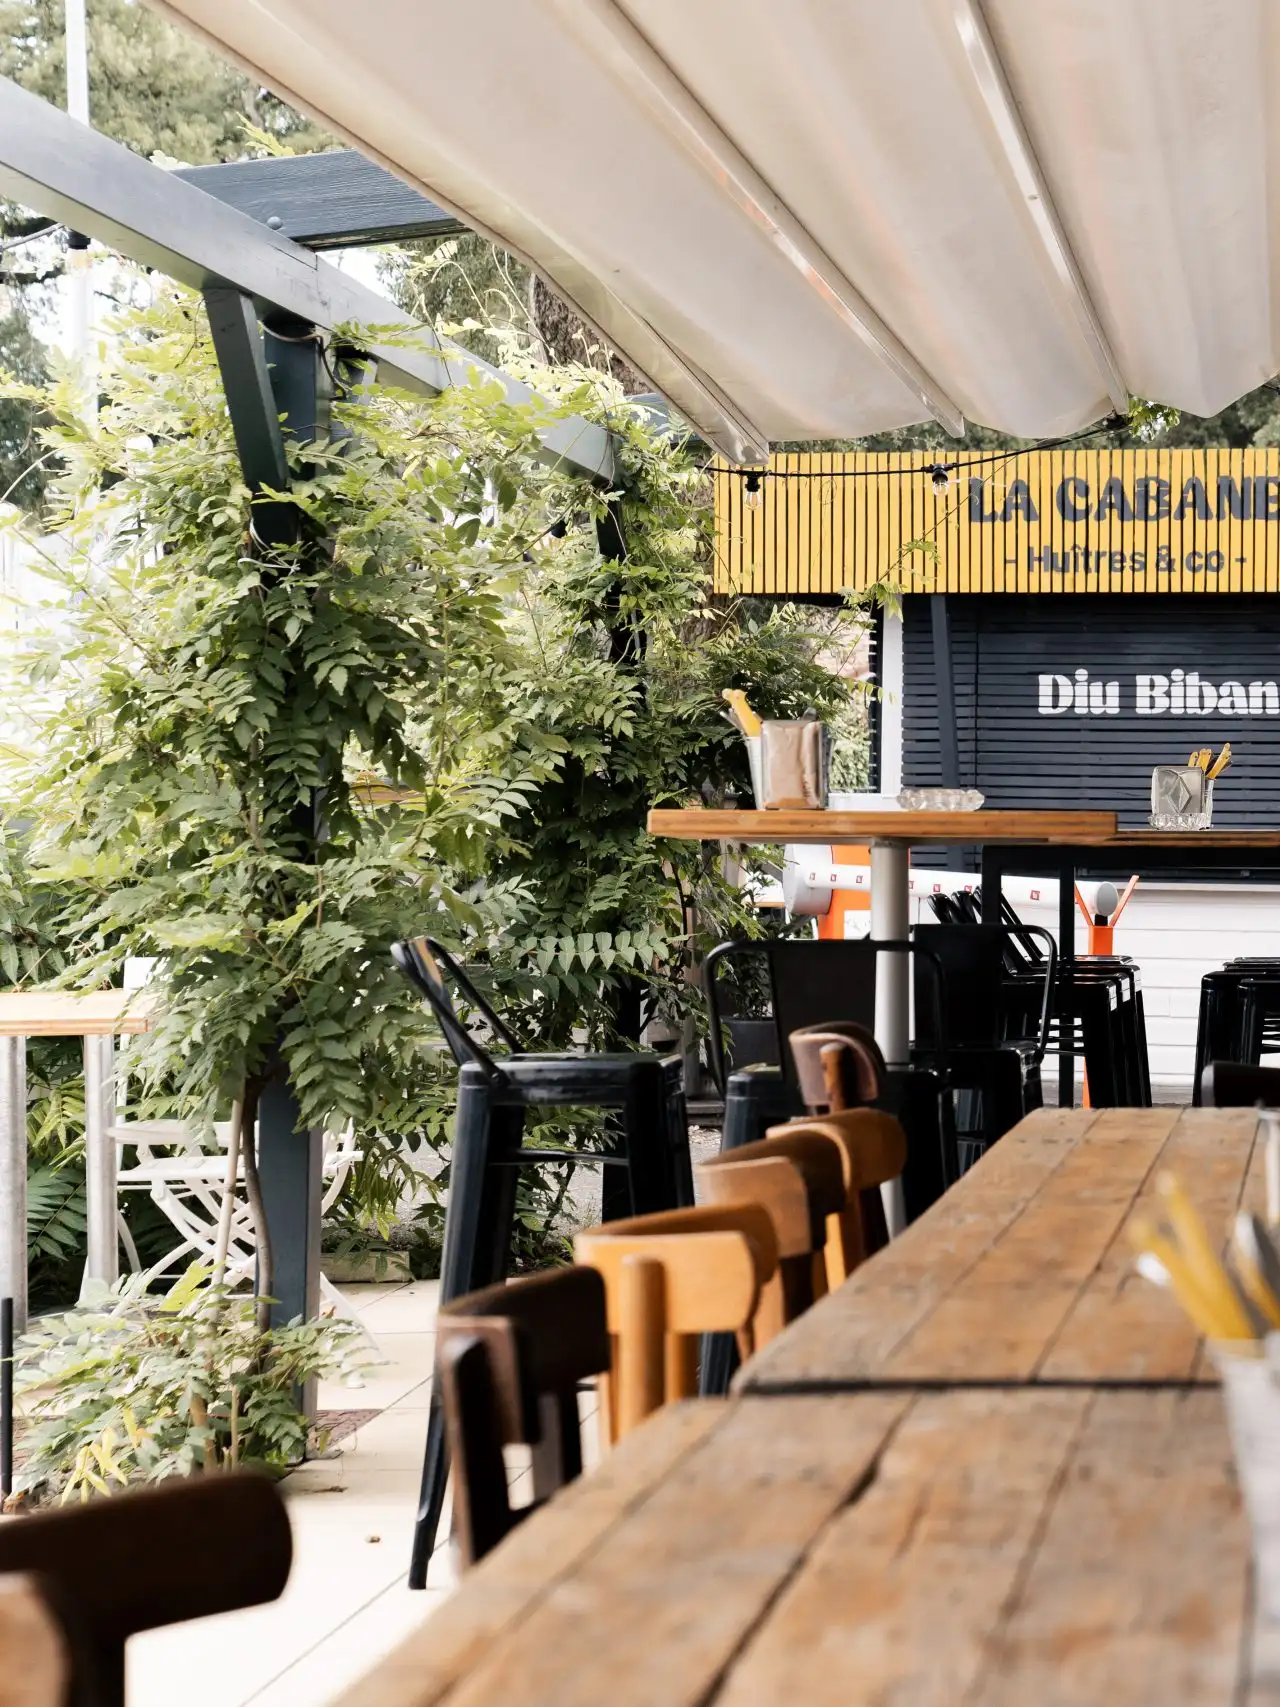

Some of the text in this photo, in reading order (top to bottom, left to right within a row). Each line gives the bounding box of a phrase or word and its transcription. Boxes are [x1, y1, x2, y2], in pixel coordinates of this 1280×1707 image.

[968, 476, 1040, 523] LA
[1027, 544, 1147, 574] Huîtres
[1154, 545, 1177, 573] &
[1184, 550, 1226, 573] co
[1037, 668, 1280, 715] Diu Biban
